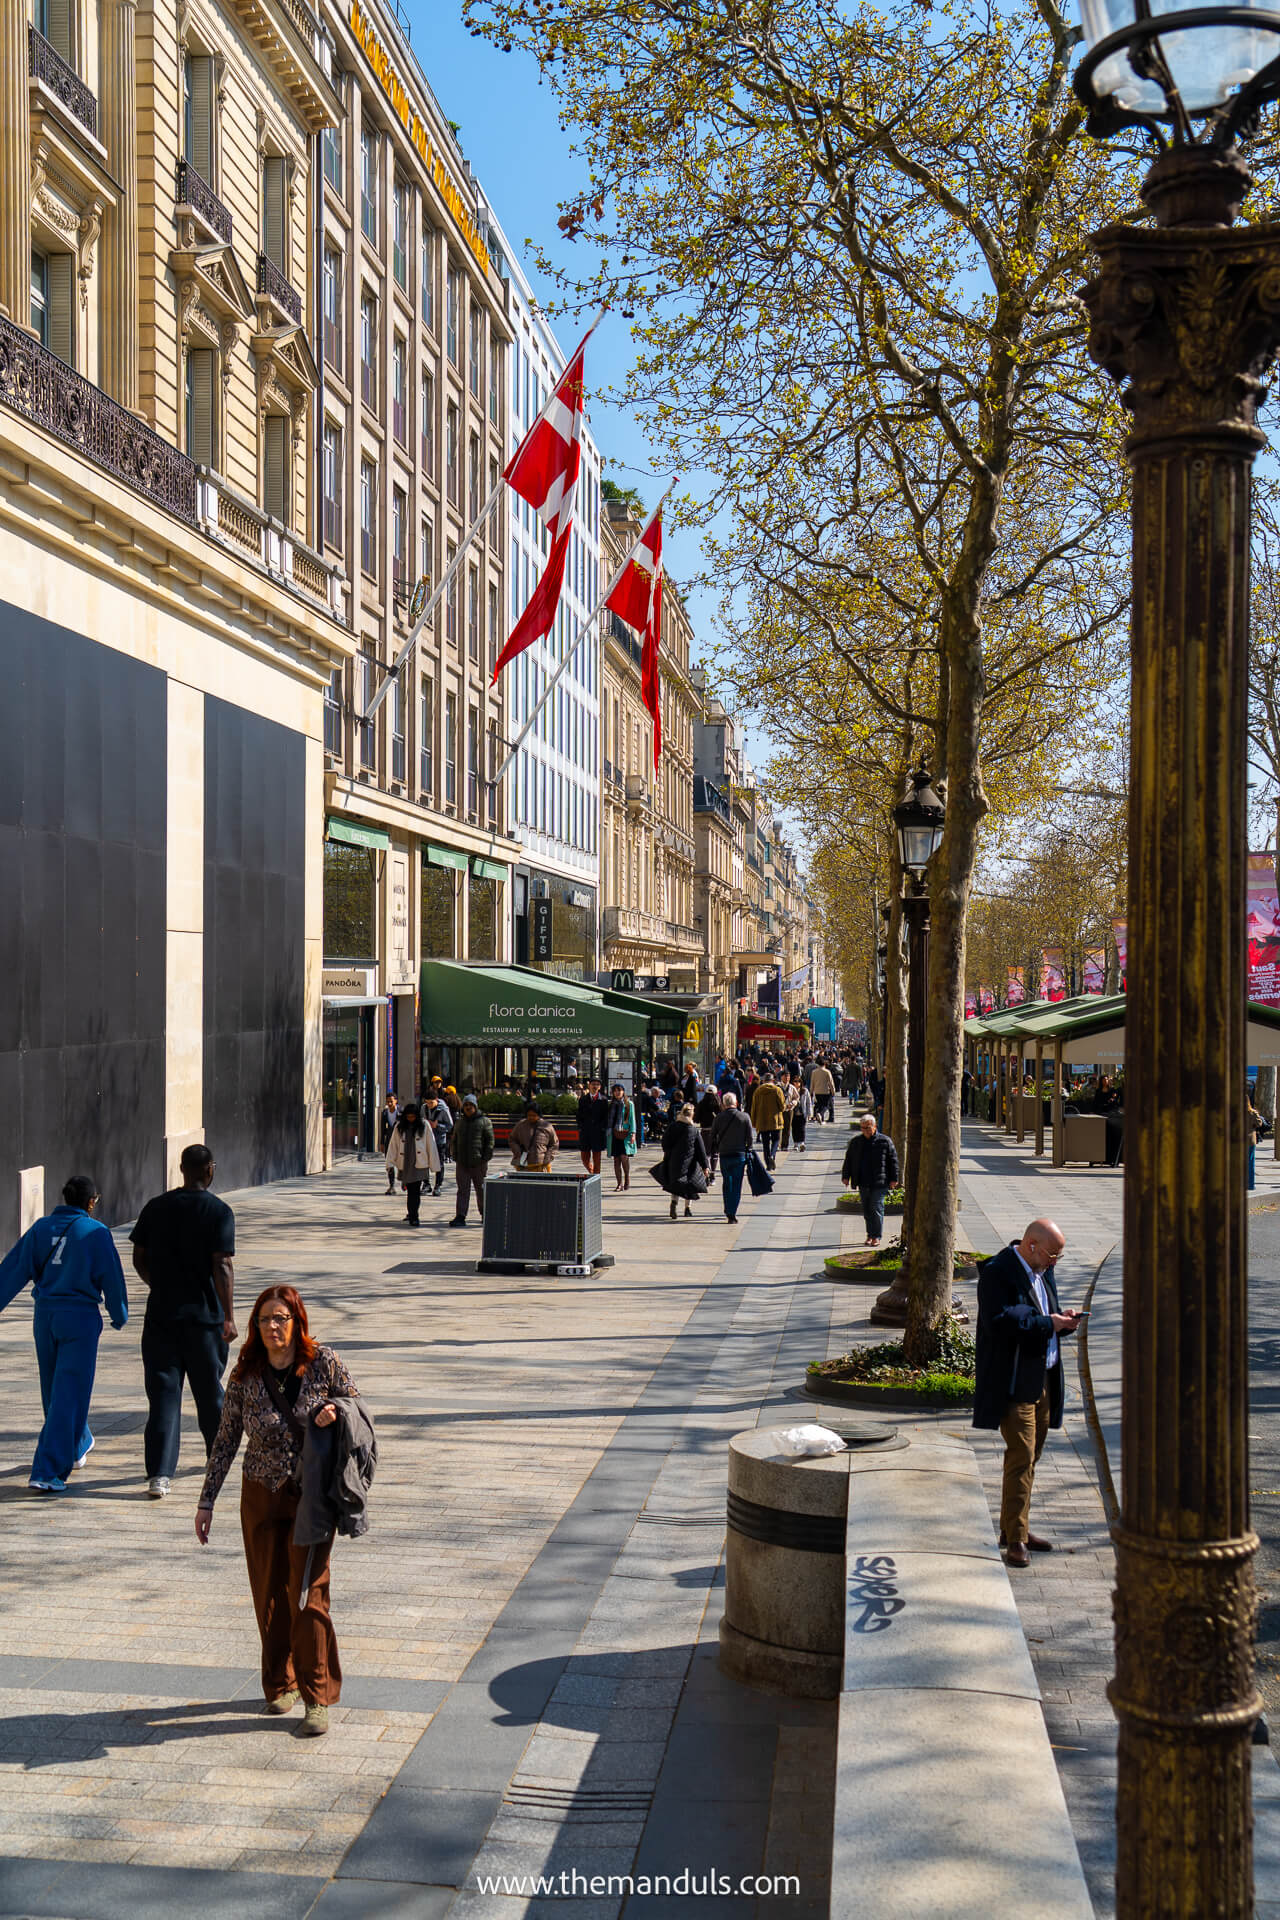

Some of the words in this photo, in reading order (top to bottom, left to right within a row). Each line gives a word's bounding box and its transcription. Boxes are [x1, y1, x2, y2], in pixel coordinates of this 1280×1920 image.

[539, 905, 548, 955] GIFTS
[489, 1003, 524, 1018] flora
[527, 1003, 576, 1017] danica
[51, 1236, 67, 1265] 7
